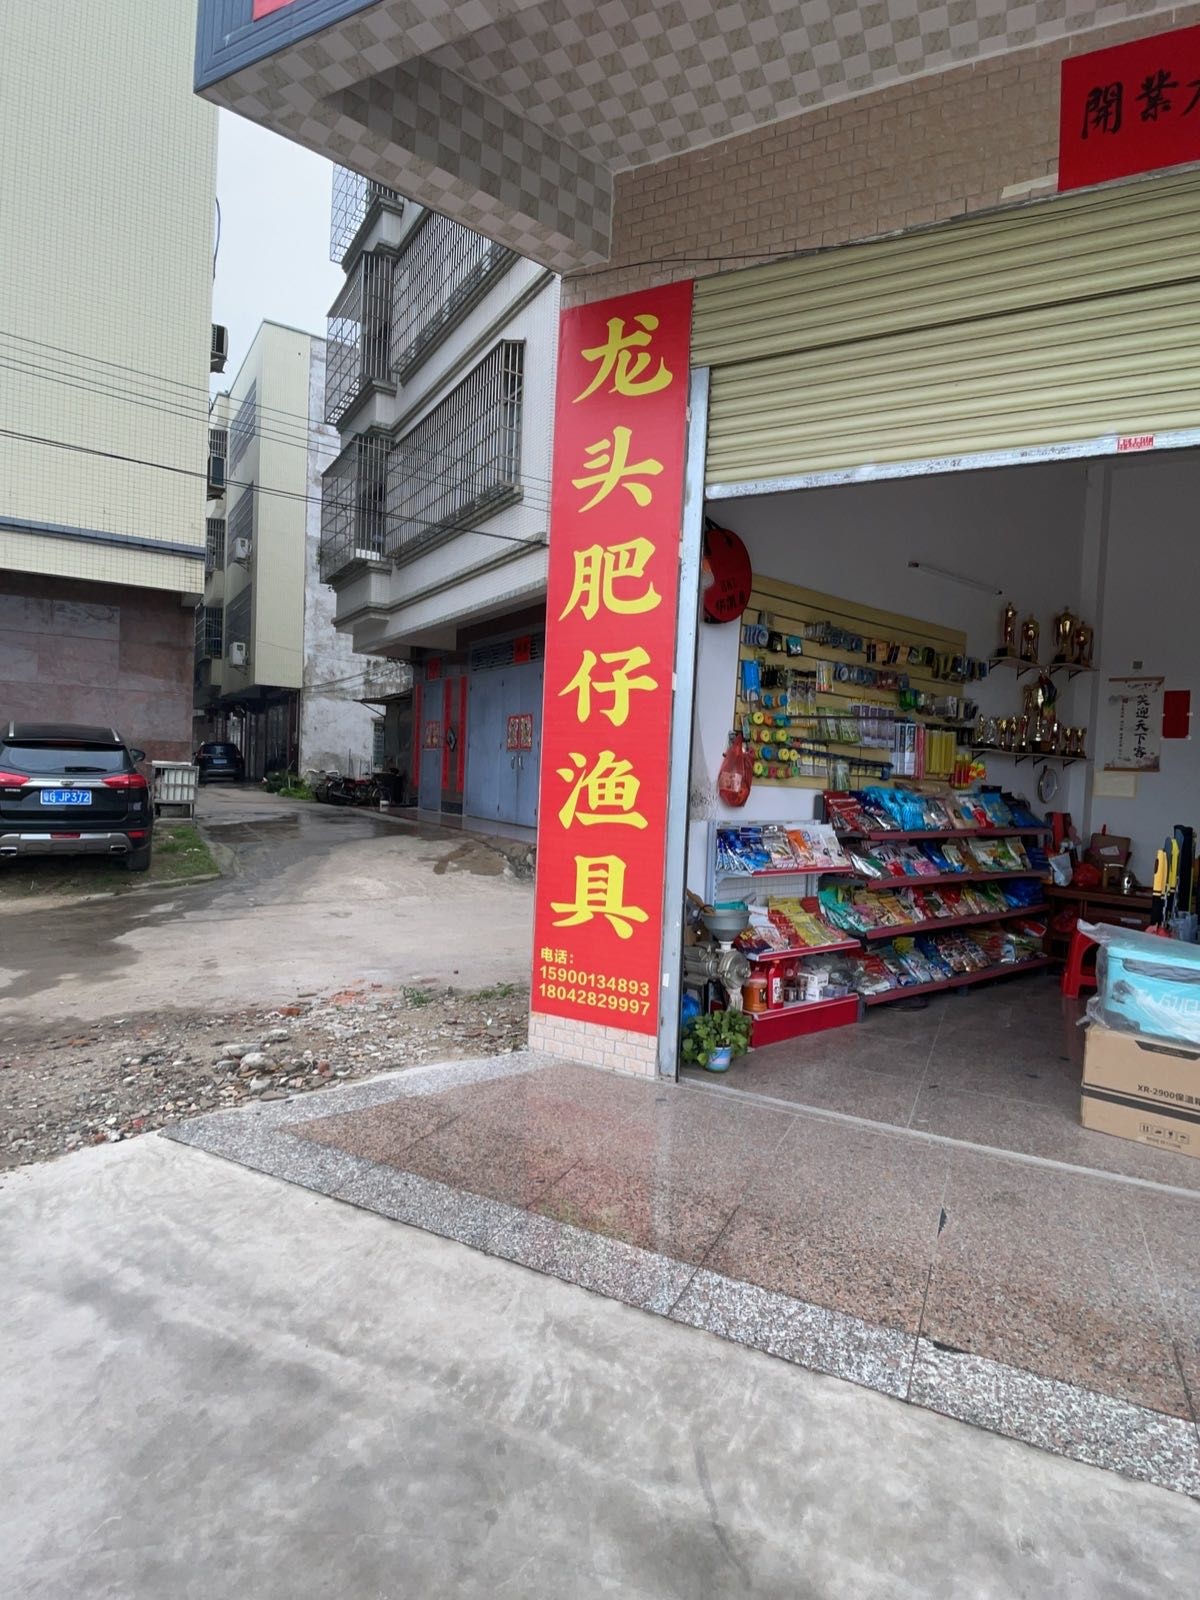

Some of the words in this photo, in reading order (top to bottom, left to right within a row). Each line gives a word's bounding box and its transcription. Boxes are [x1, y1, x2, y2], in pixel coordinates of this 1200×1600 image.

[550, 313, 673, 940] 龙头肥仔渔具
[1133, 694, 1151, 758] 笑迎天下客
[539, 983, 650, 1016] 18042829997
[540, 965, 649, 997] 15900134893
